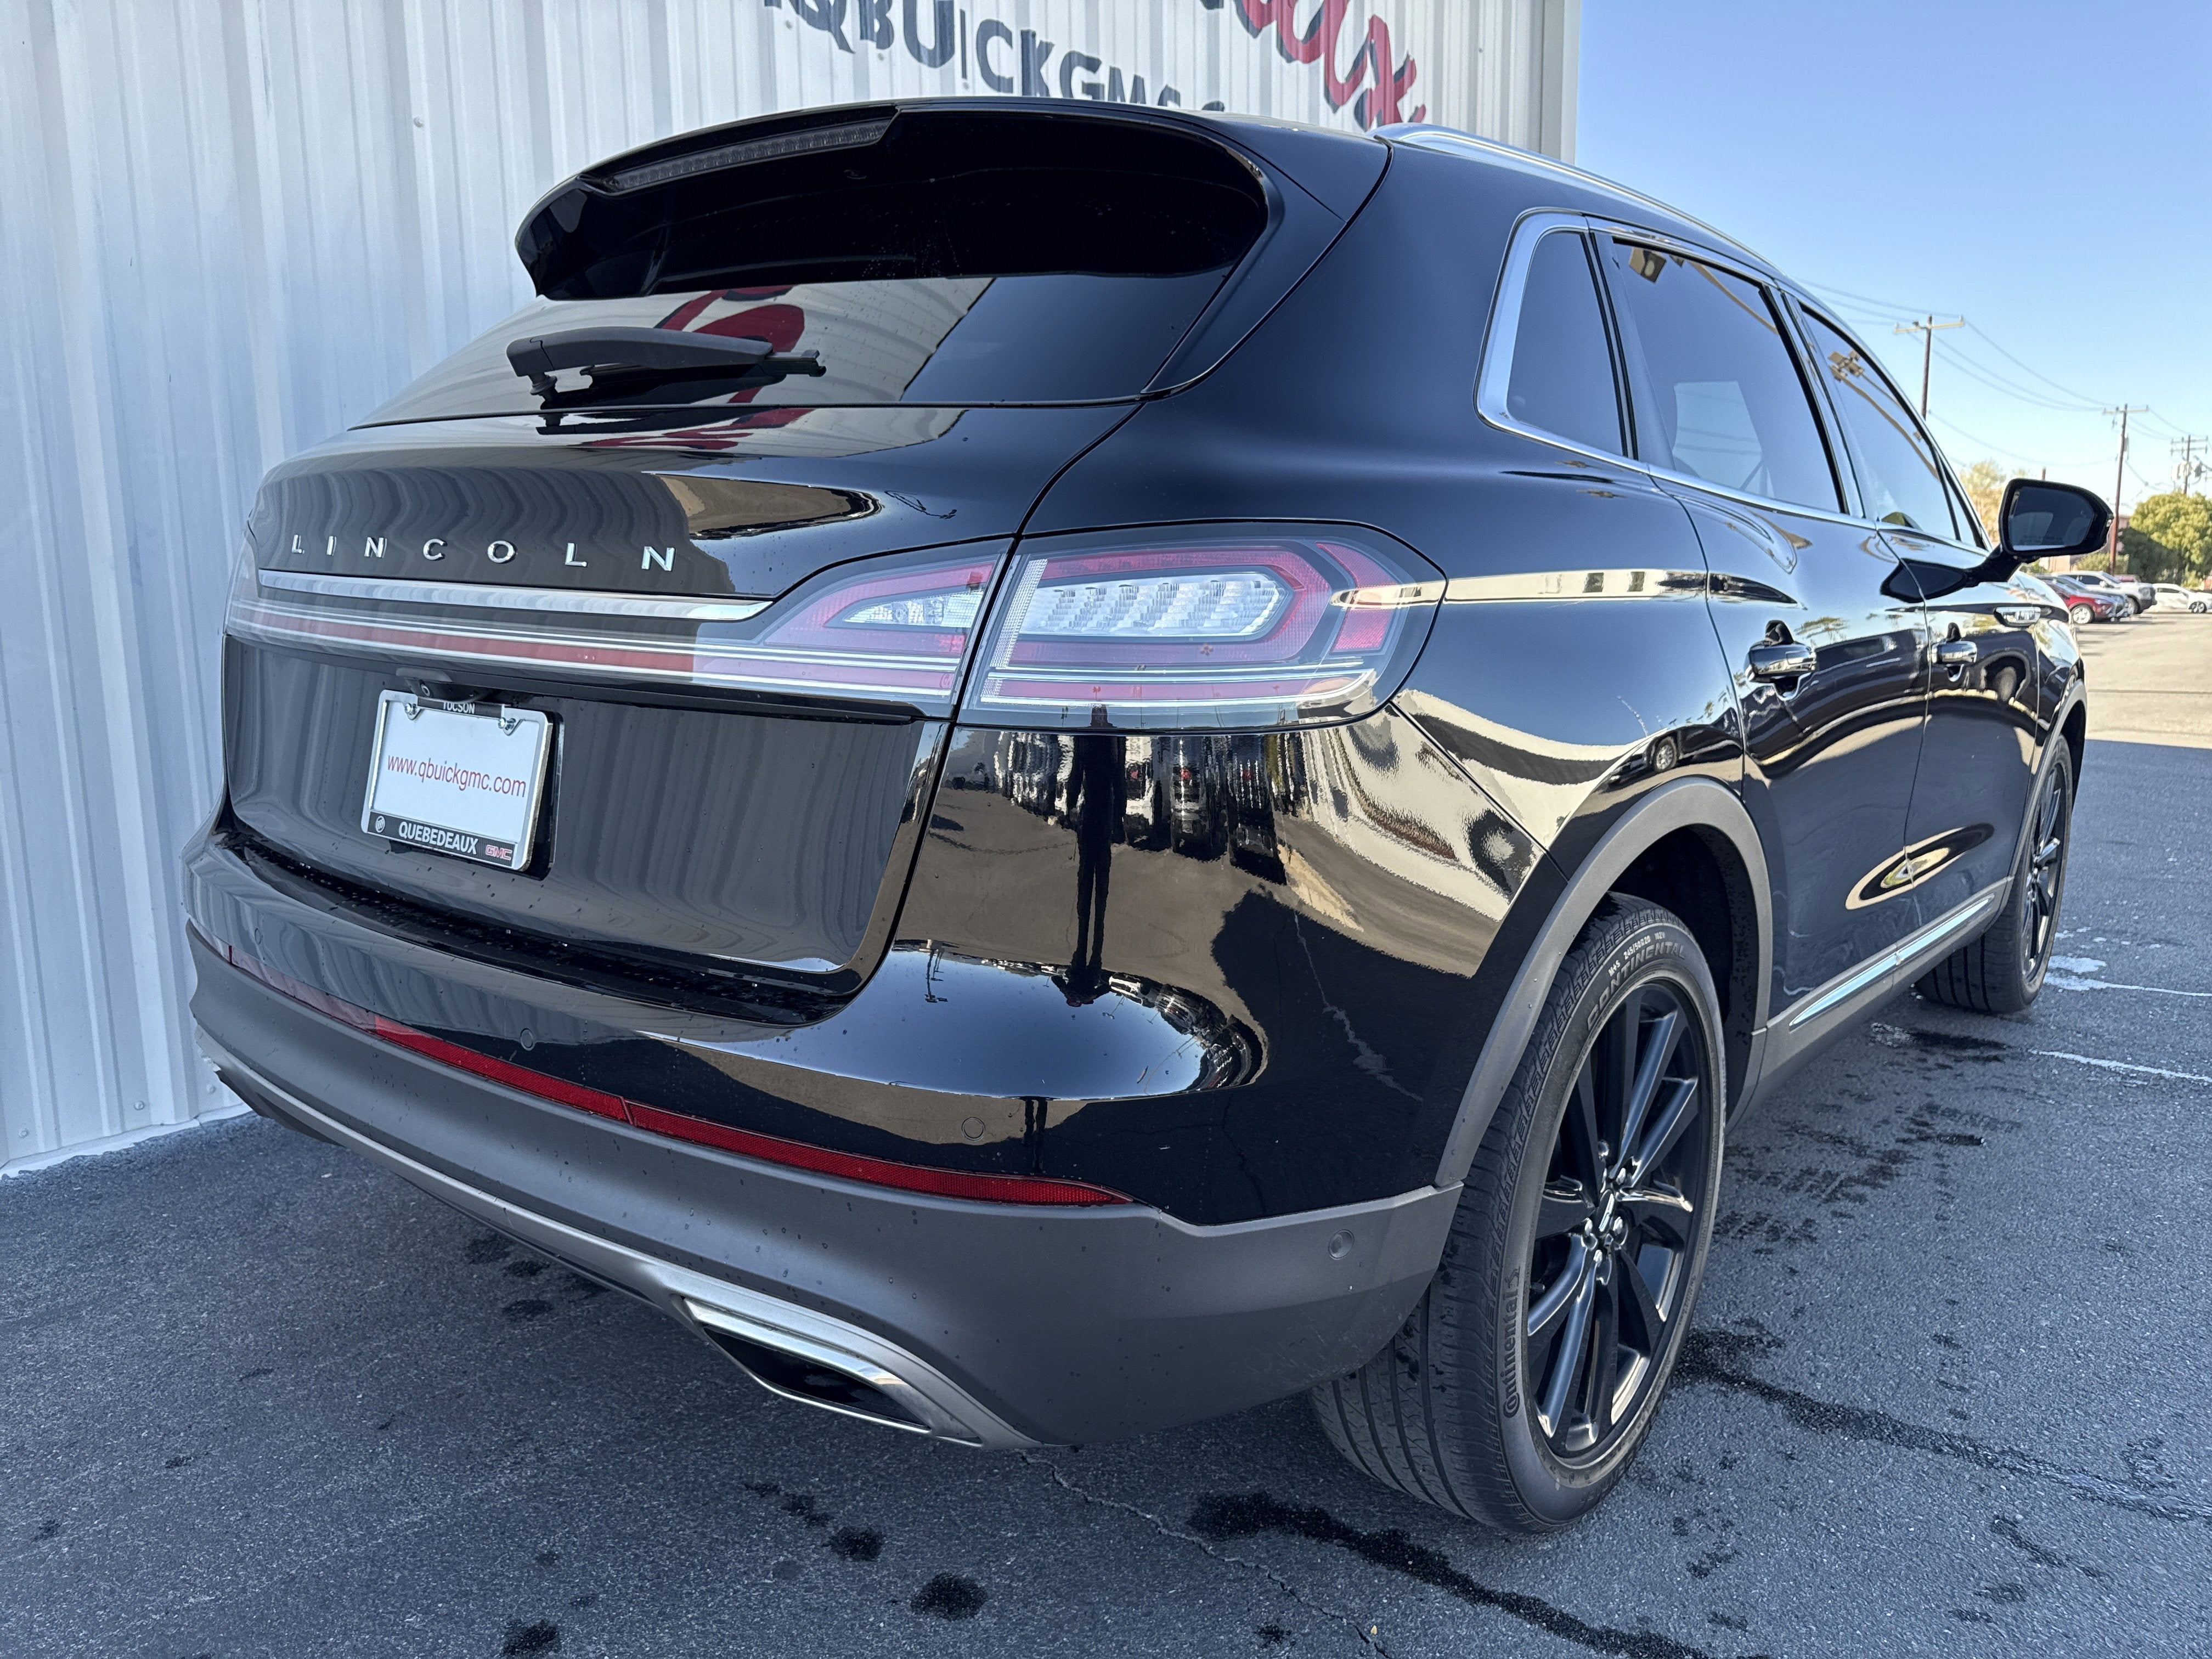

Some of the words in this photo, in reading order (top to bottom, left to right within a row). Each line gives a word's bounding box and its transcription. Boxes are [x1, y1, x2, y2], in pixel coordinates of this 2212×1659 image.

[291, 534, 675, 572] LINCOLN
[443, 702, 475, 714] TUCSON
[387, 755, 527, 798] www.qbuickgmc.com
[399, 821, 479, 855] QUEBEDEAUX
[485, 845, 512, 861] GMC
[1608, 960, 1621, 977] M+S
[1623, 935, 1651, 960] 245/50R20
[1587, 941, 1685, 1030] CONTINENTAL
[1500, 1289, 1520, 1418] Continental
